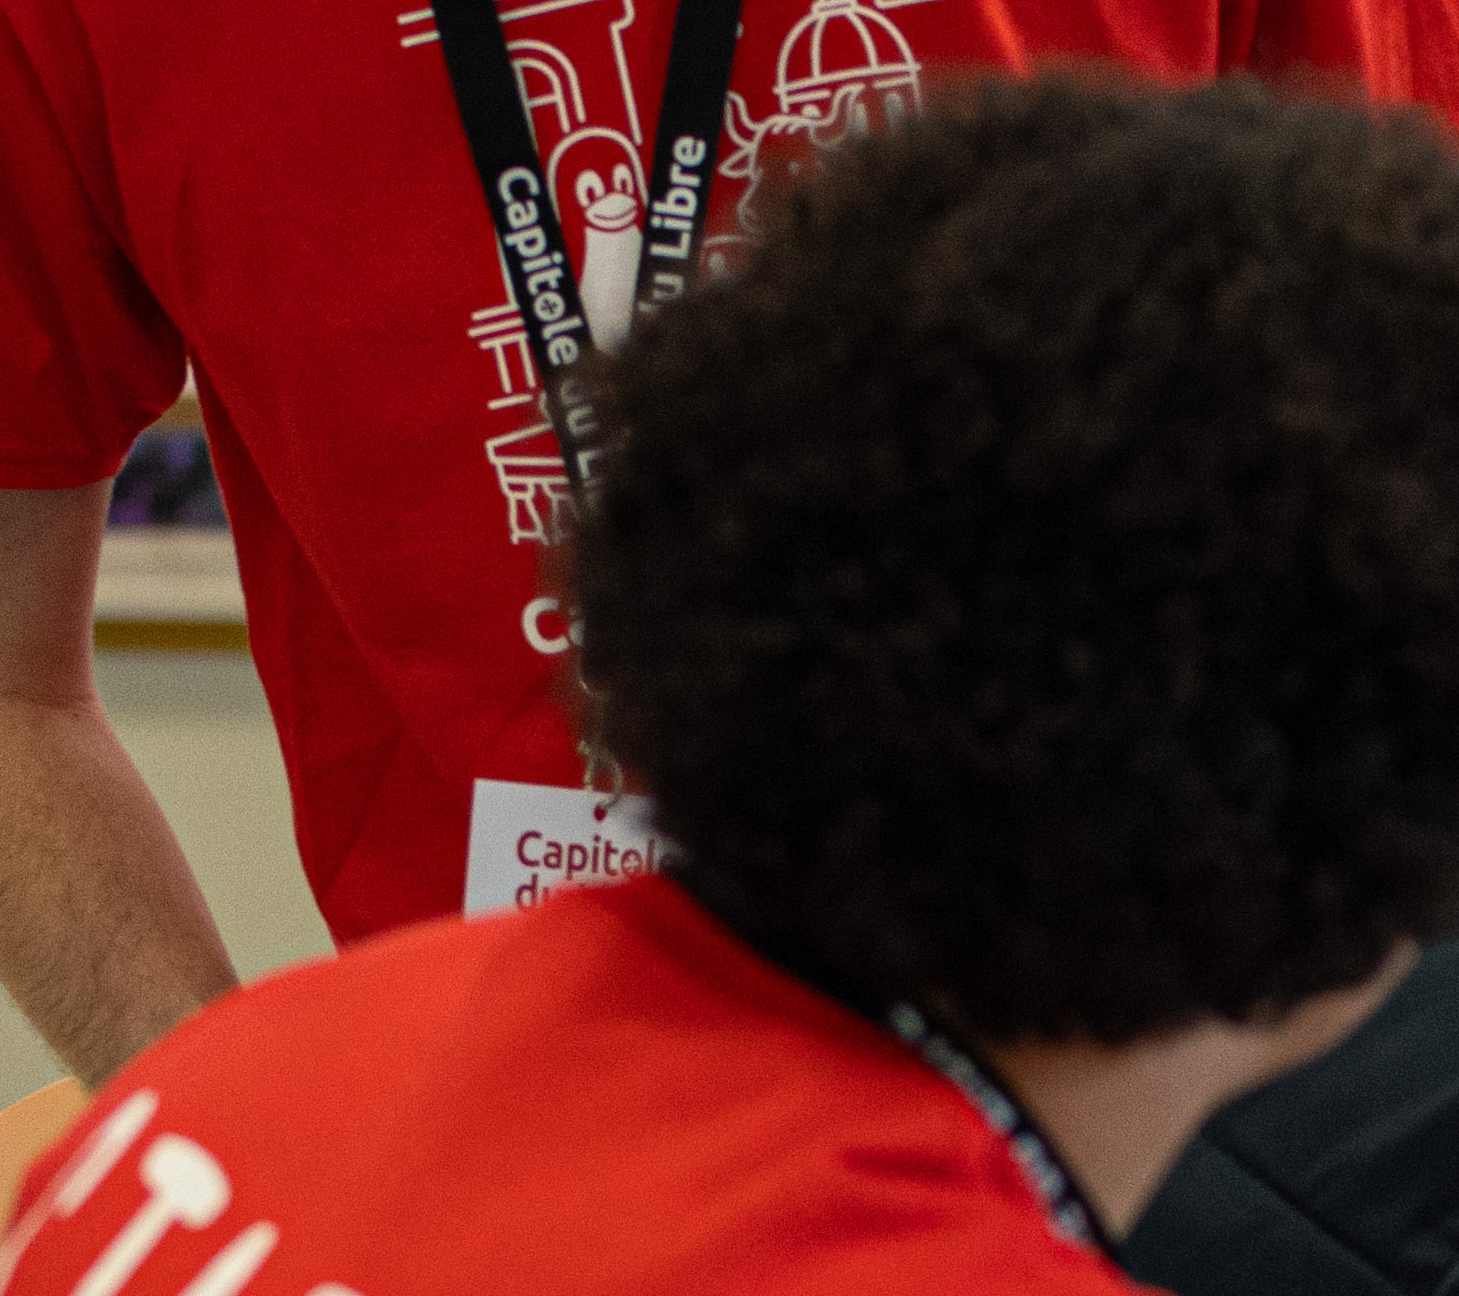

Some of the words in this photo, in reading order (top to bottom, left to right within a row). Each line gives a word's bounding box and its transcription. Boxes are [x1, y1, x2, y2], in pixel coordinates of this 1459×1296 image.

[648, 134, 709, 262] Libre
[496, 165, 585, 368] Capitole
[515, 829, 659, 882] Capitol
